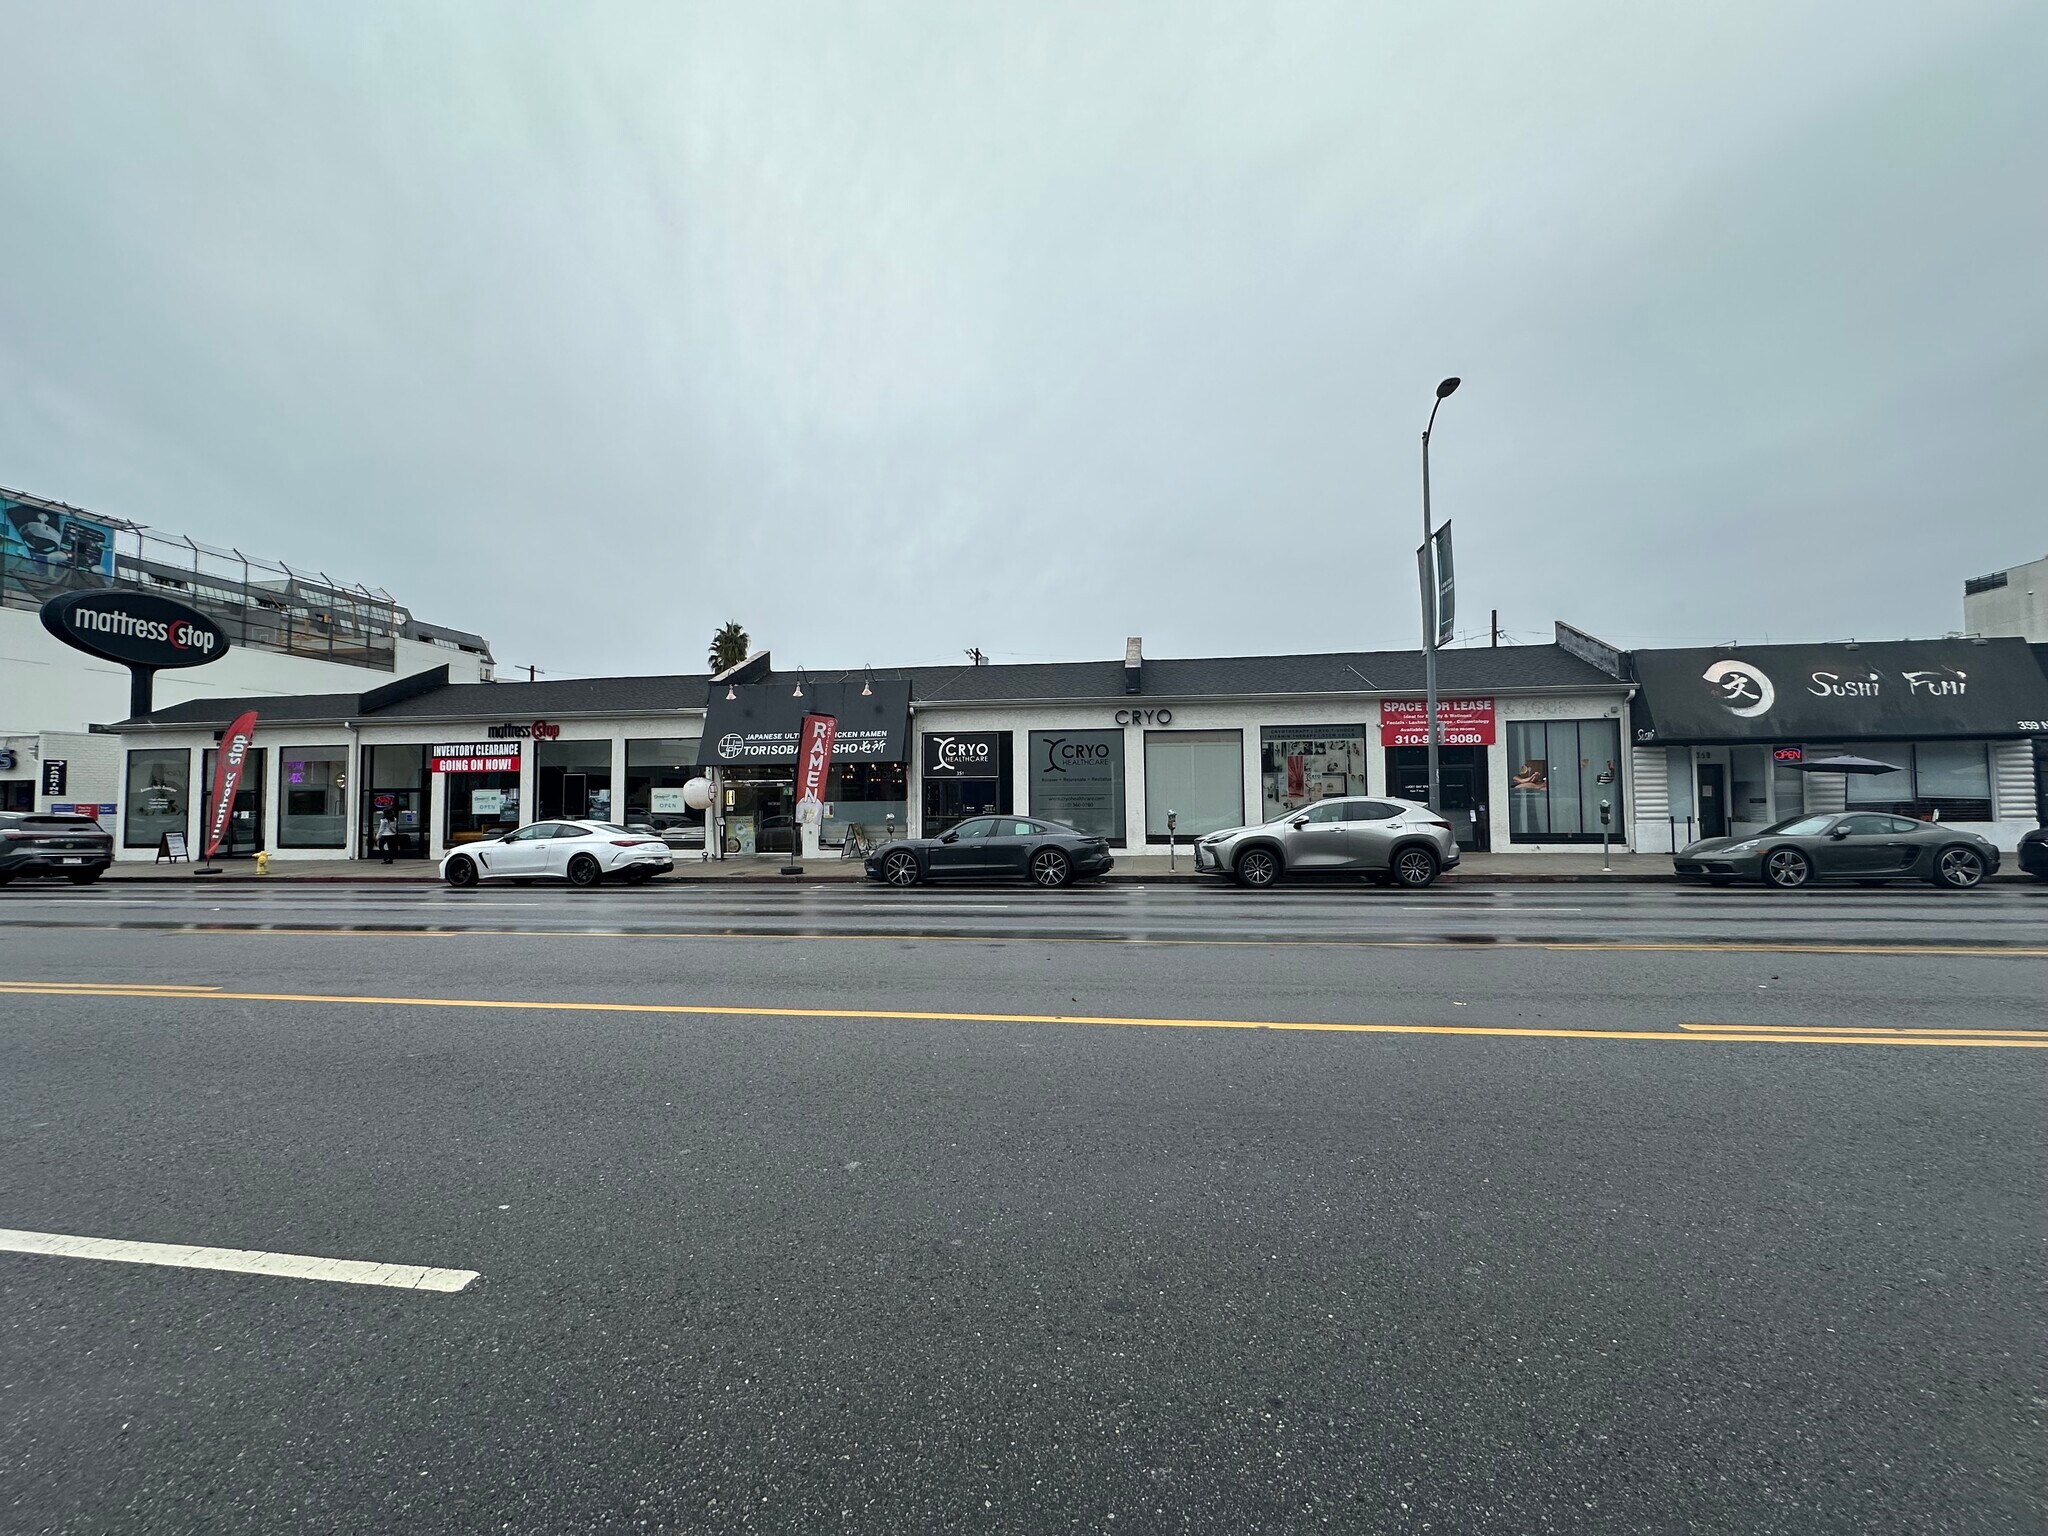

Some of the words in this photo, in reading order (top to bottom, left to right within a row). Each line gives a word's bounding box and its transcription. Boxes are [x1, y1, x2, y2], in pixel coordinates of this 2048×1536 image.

[75, 608, 168, 641] mattress
[178, 625, 215, 654] stop
[1383, 702, 1423, 712] SPACE
[1426, 701, 1450, 711] OR
[1453, 700, 1492, 711] LEASE
[1115, 709, 1172, 725] CRYO
[488, 723, 531, 739] mattress
[535, 721, 560, 740] stop
[2017, 720, 2040, 730] 359
[1394, 733, 1482, 744] 310-9-9080
[228, 734, 248, 765] stop
[433, 744, 475, 757] INVENTORY
[475, 743, 519, 756] CLEARANCE
[945, 743, 989, 756] CRYO
[1061, 744, 1109, 759] CRYO
[1774, 749, 1801, 760] OPEN
[439, 759, 469, 771] GOING
[470, 759, 484, 771] ON
[485, 758, 512, 770] NOW!
[803, 721, 827, 804] RAMEN
[1062, 758, 1109, 766] HEALTHCARE
[48, 766, 60, 795] PARKING
